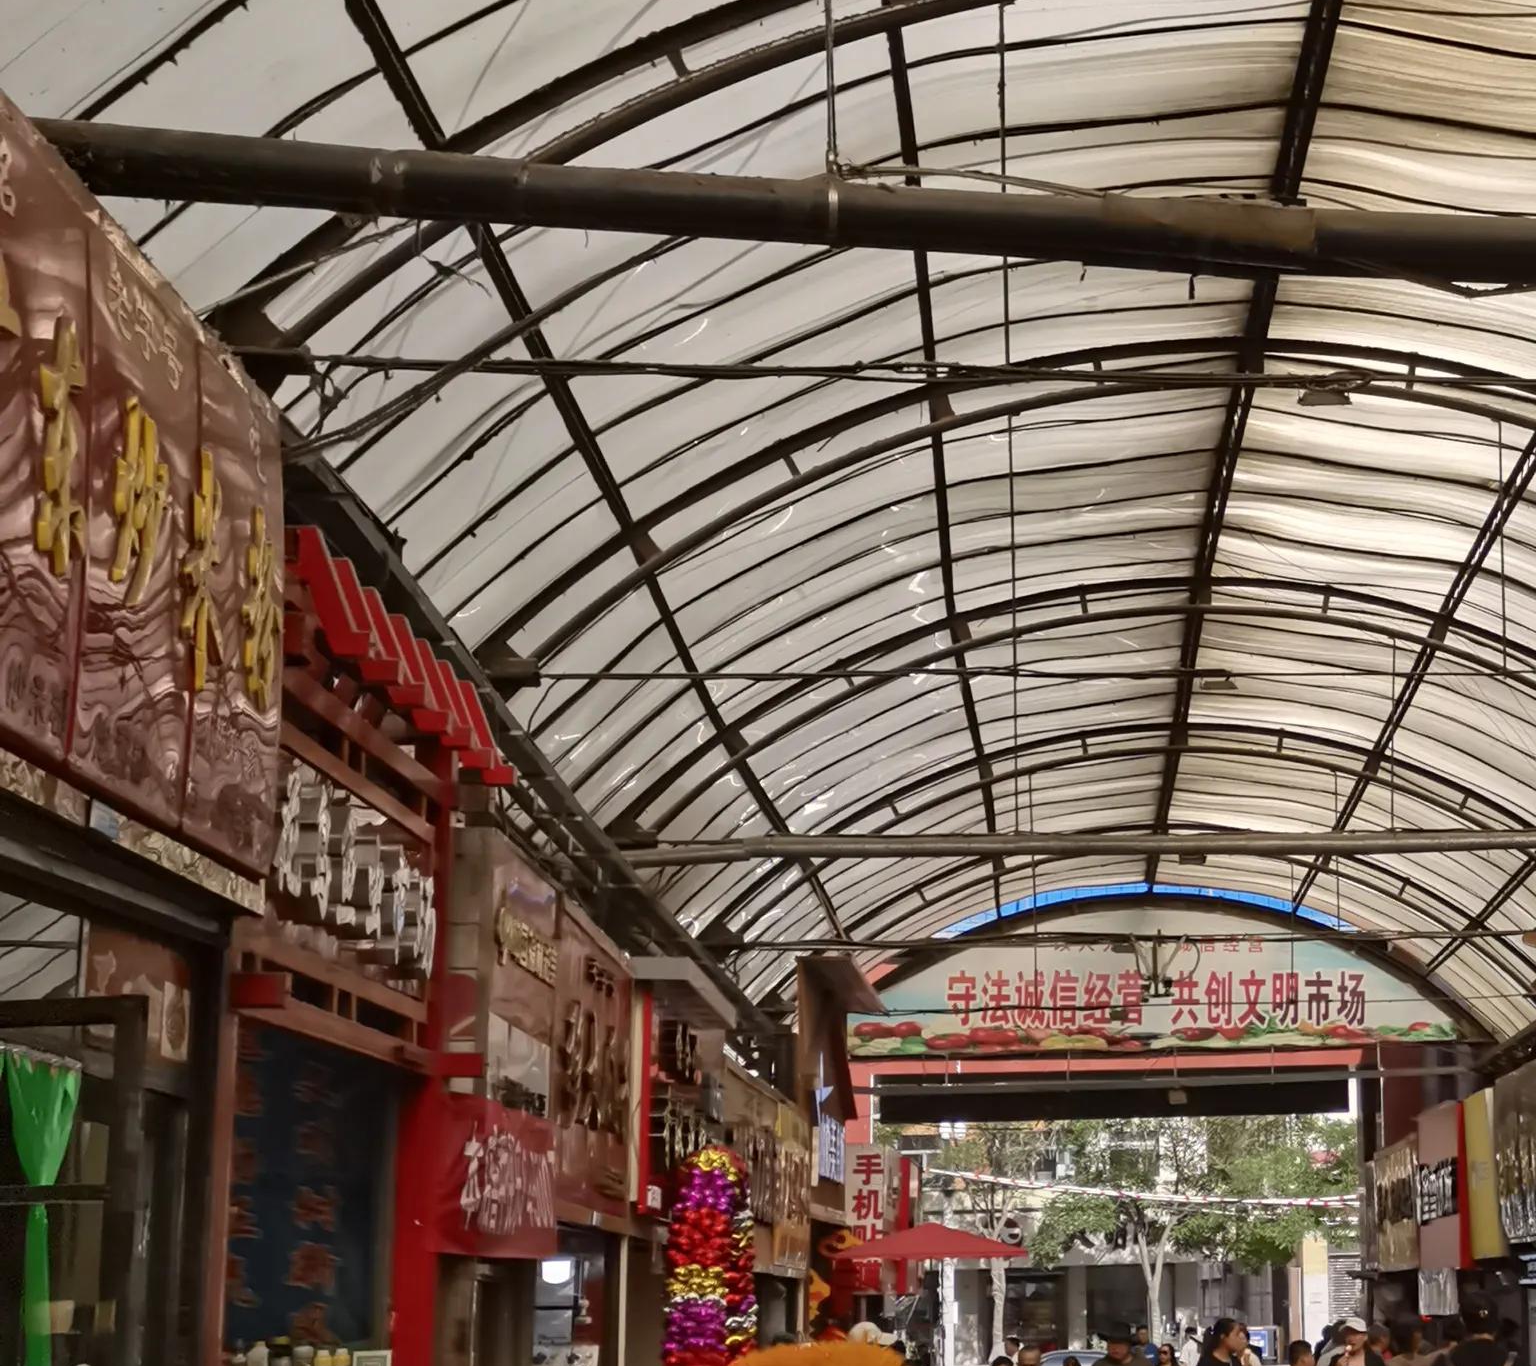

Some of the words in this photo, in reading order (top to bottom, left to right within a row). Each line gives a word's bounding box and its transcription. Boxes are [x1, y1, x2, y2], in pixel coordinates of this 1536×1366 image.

[946, 969, 1144, 1028] 守法诚信经营
[1171, 969, 1367, 1028] 共创文明市场
